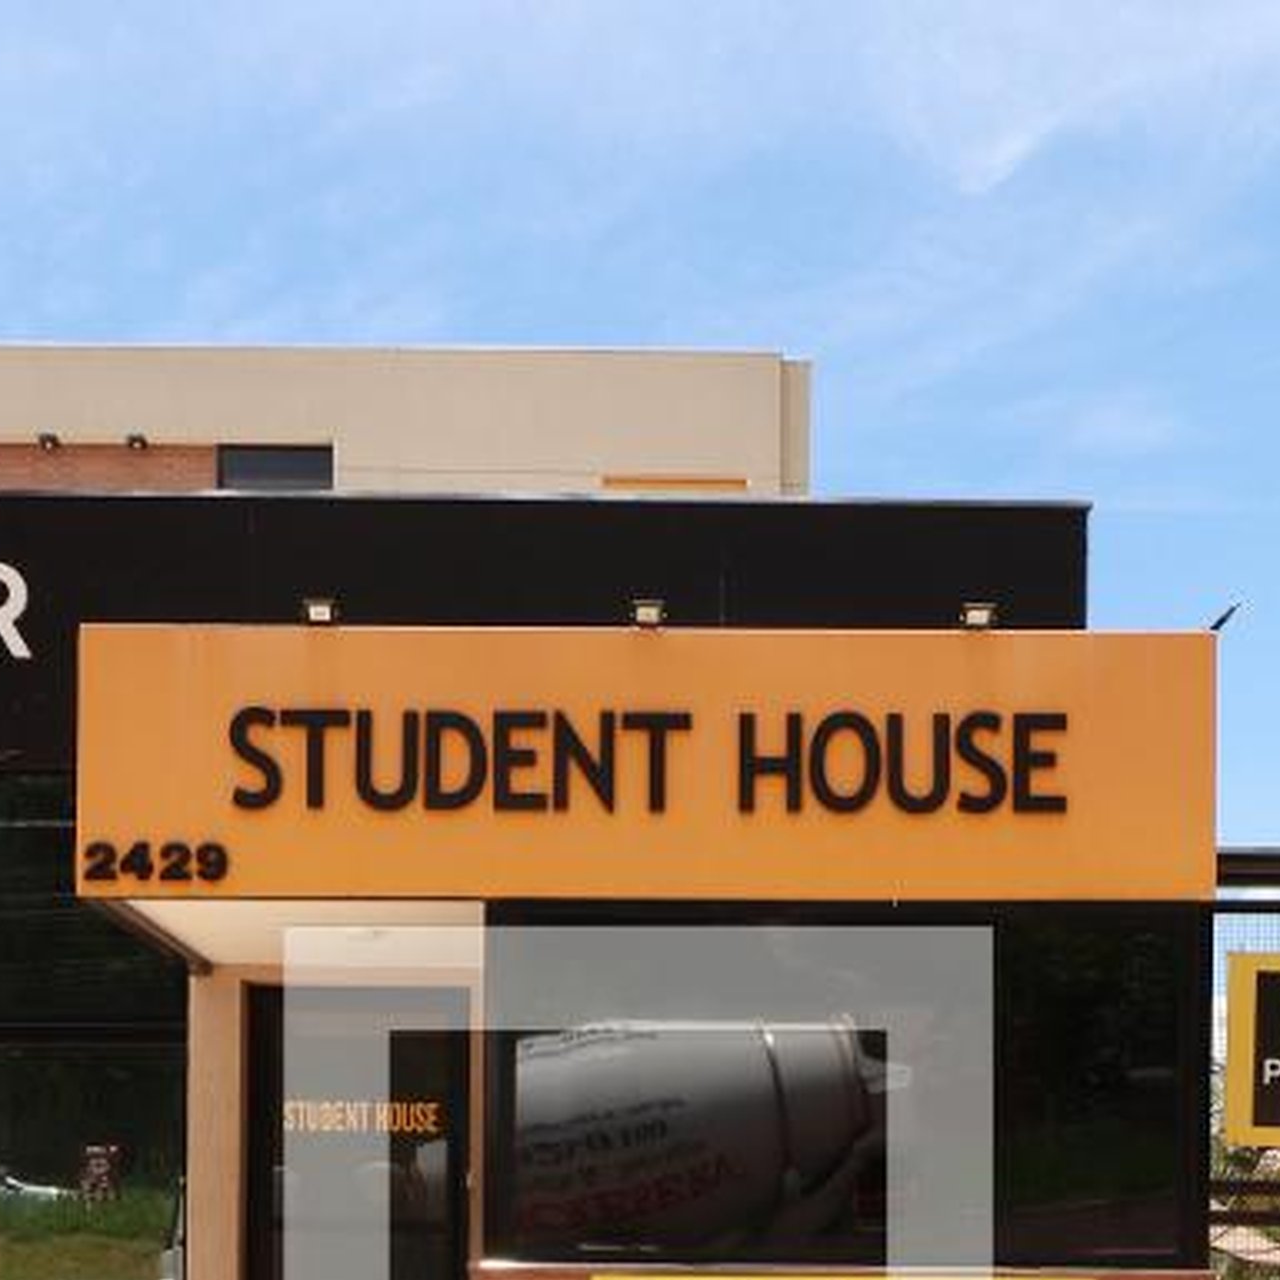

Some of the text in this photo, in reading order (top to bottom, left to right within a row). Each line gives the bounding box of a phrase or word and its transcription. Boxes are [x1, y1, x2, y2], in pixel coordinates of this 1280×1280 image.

[228, 706, 1068, 816] STUDENT HOUSE
[83, 841, 229, 884] 2429
[284, 1101, 439, 1132] STUDENT HOUSE
